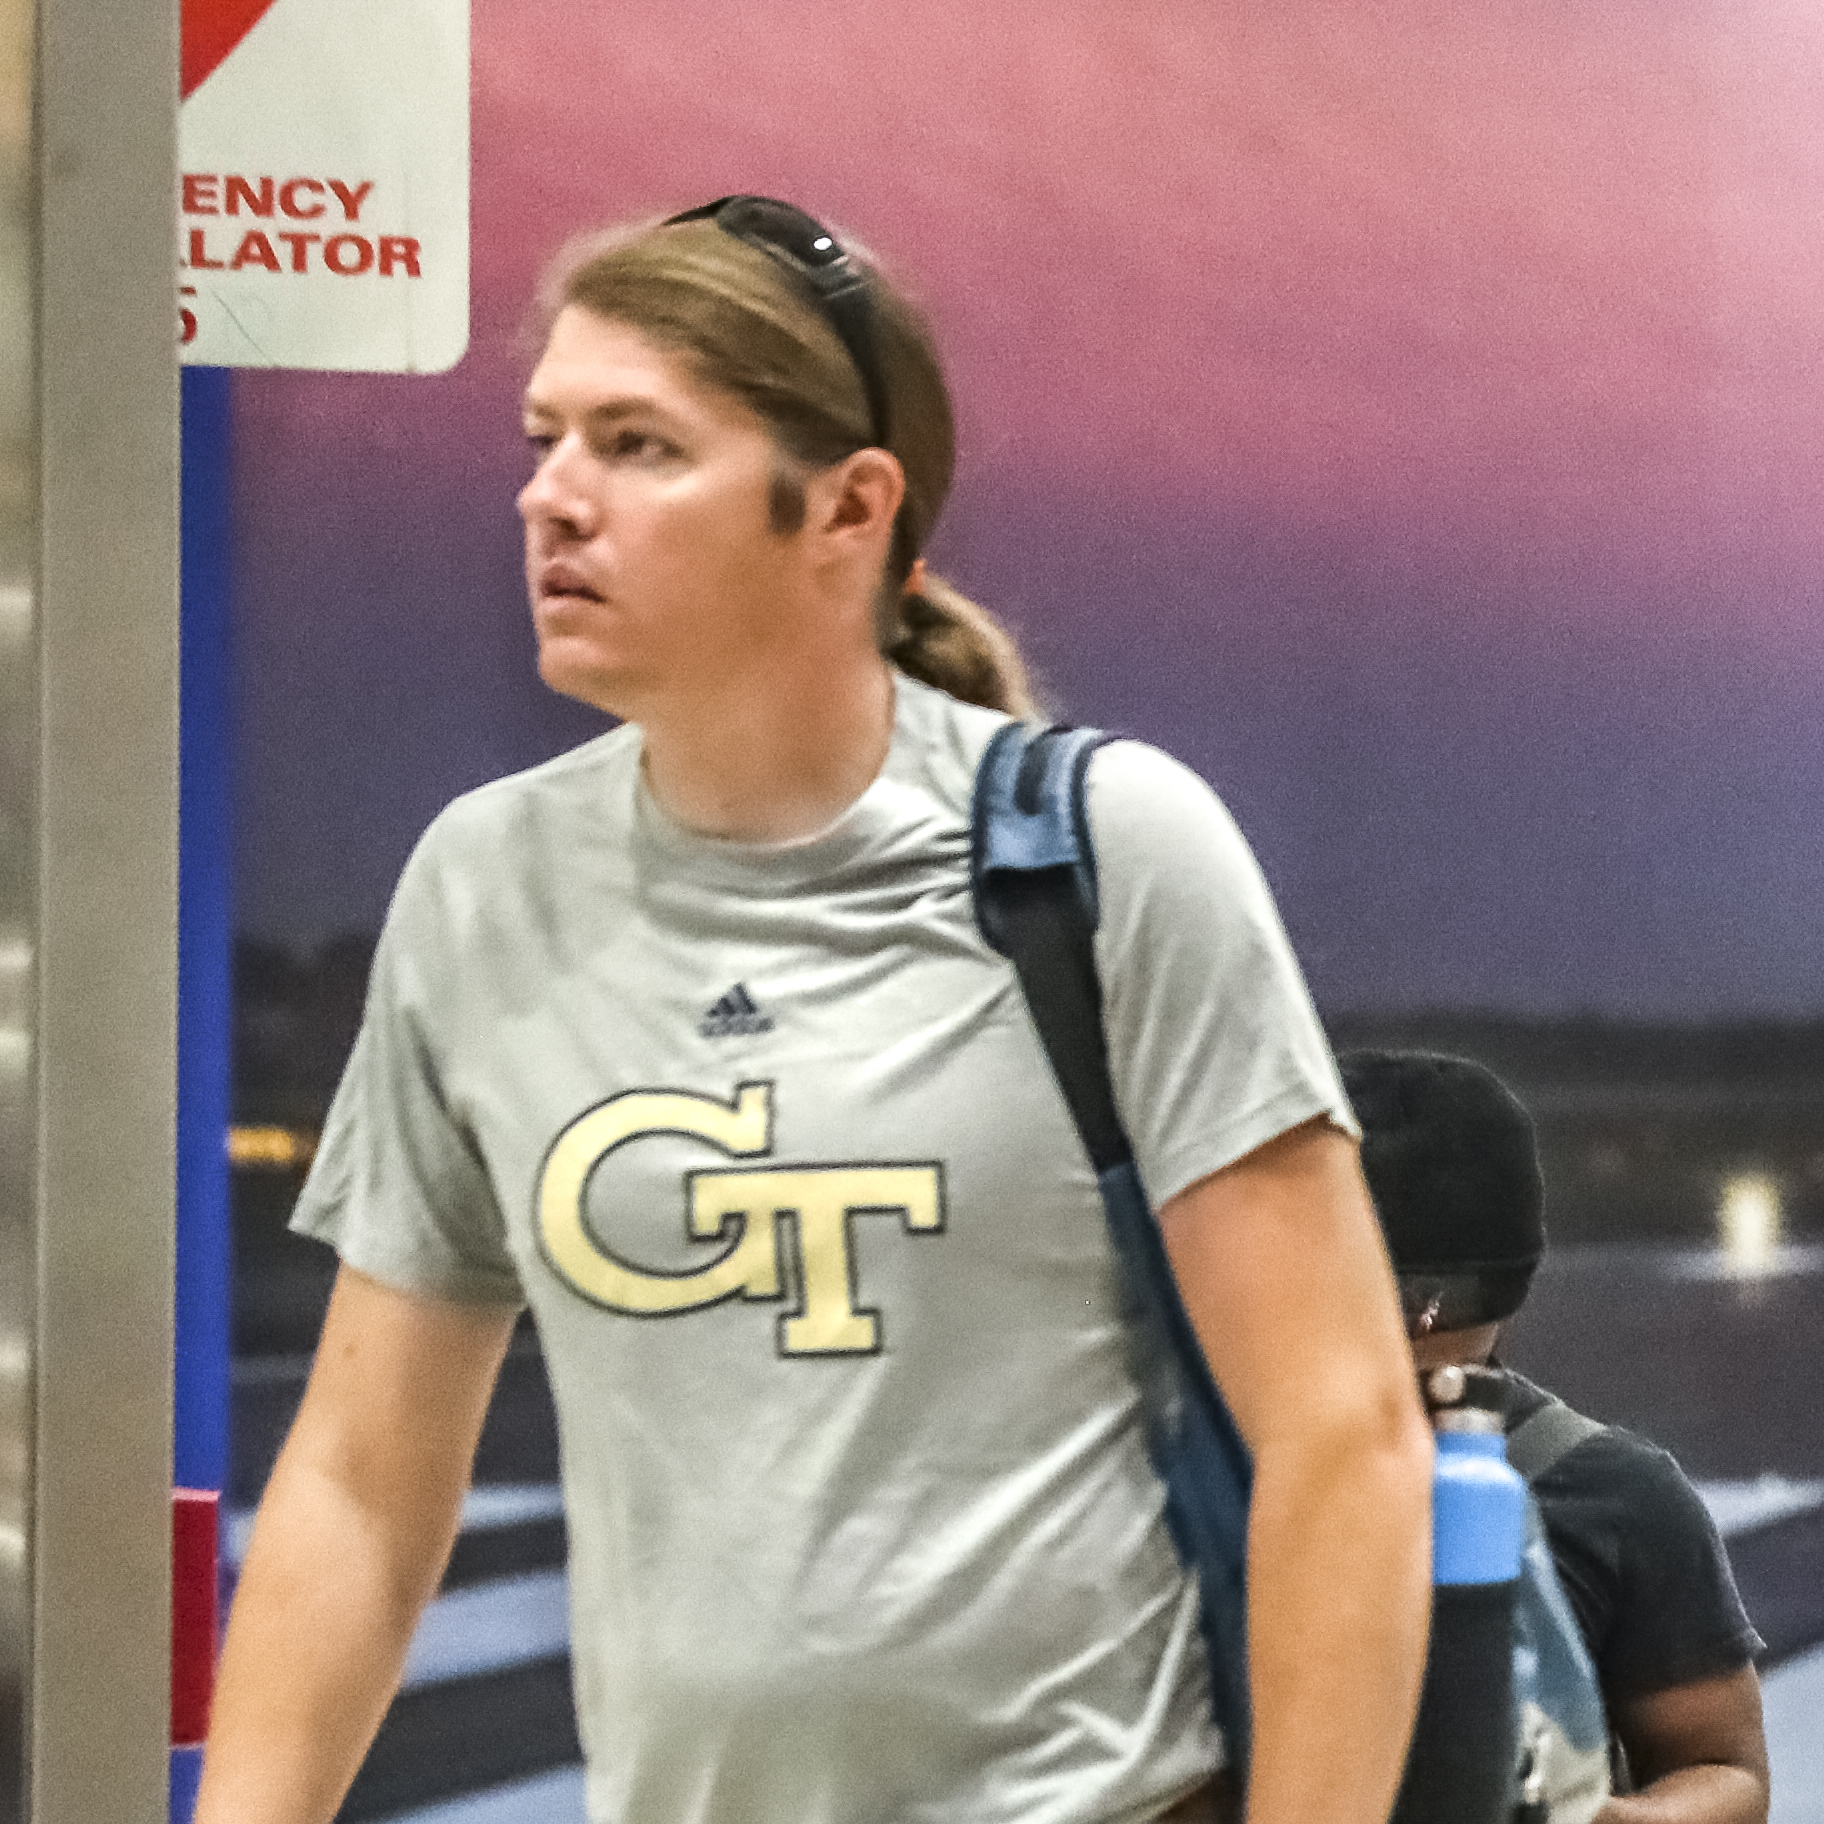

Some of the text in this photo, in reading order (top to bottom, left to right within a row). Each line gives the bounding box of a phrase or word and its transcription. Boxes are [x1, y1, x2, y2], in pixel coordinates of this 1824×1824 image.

[182, 173, 374, 221] ENCY
[180, 228, 422, 278] LATOR
[536, 1079, 946, 1358] GT
